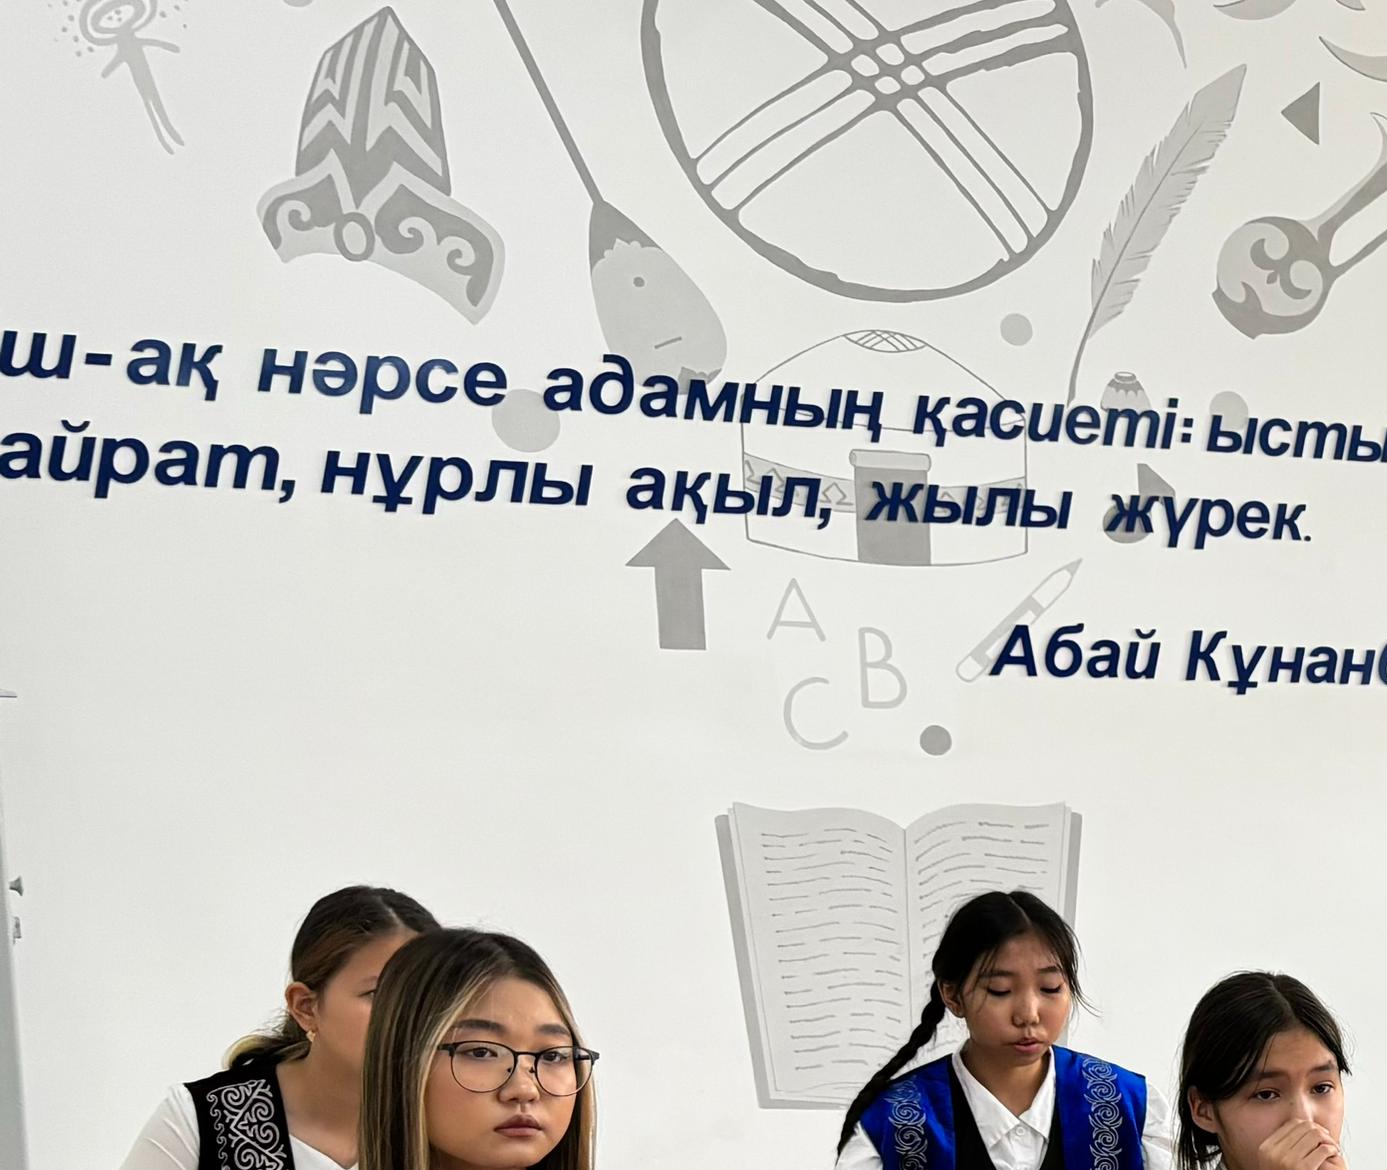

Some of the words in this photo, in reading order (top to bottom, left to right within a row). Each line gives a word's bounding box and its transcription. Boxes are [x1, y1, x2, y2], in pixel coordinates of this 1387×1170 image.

[257, 348, 508, 414] нәрсе
[543, 354, 884, 442] адамның
[913, 396, 1194, 450] қасиеті:
[321, 451, 594, 514] нұрлы
[625, 466, 833, 530] ақыл,
[867, 481, 1072, 530] жылы
[1107, 494, 1312, 550] жүрек.
[989, 624, 1161, 682] Абай
